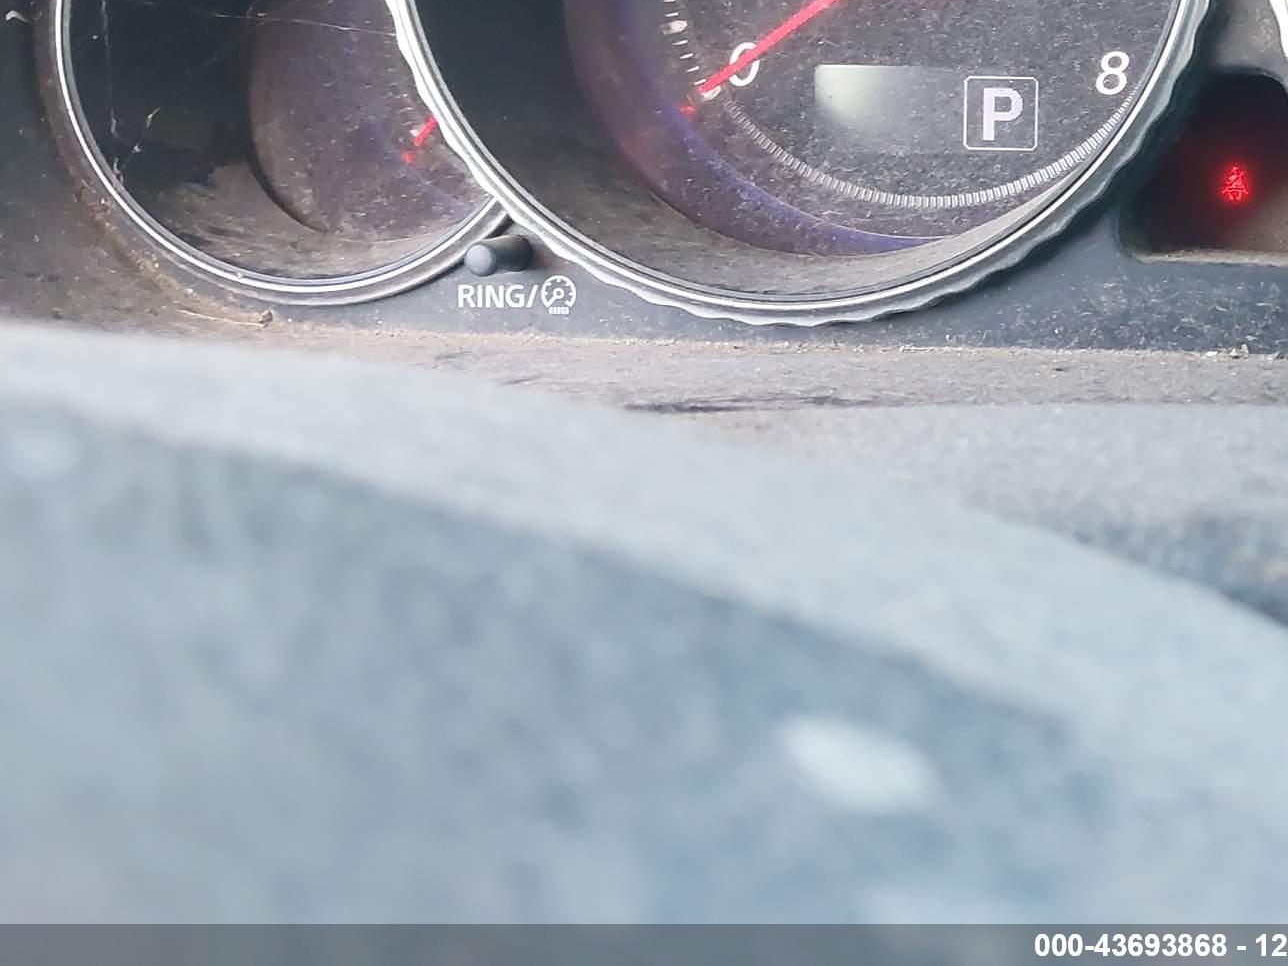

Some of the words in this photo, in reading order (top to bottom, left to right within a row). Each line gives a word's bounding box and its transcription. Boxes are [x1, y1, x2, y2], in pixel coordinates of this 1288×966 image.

[730, 42, 760, 87] 0
[1096, 51, 1129, 96] 8
[983, 87, 1024, 141] P
